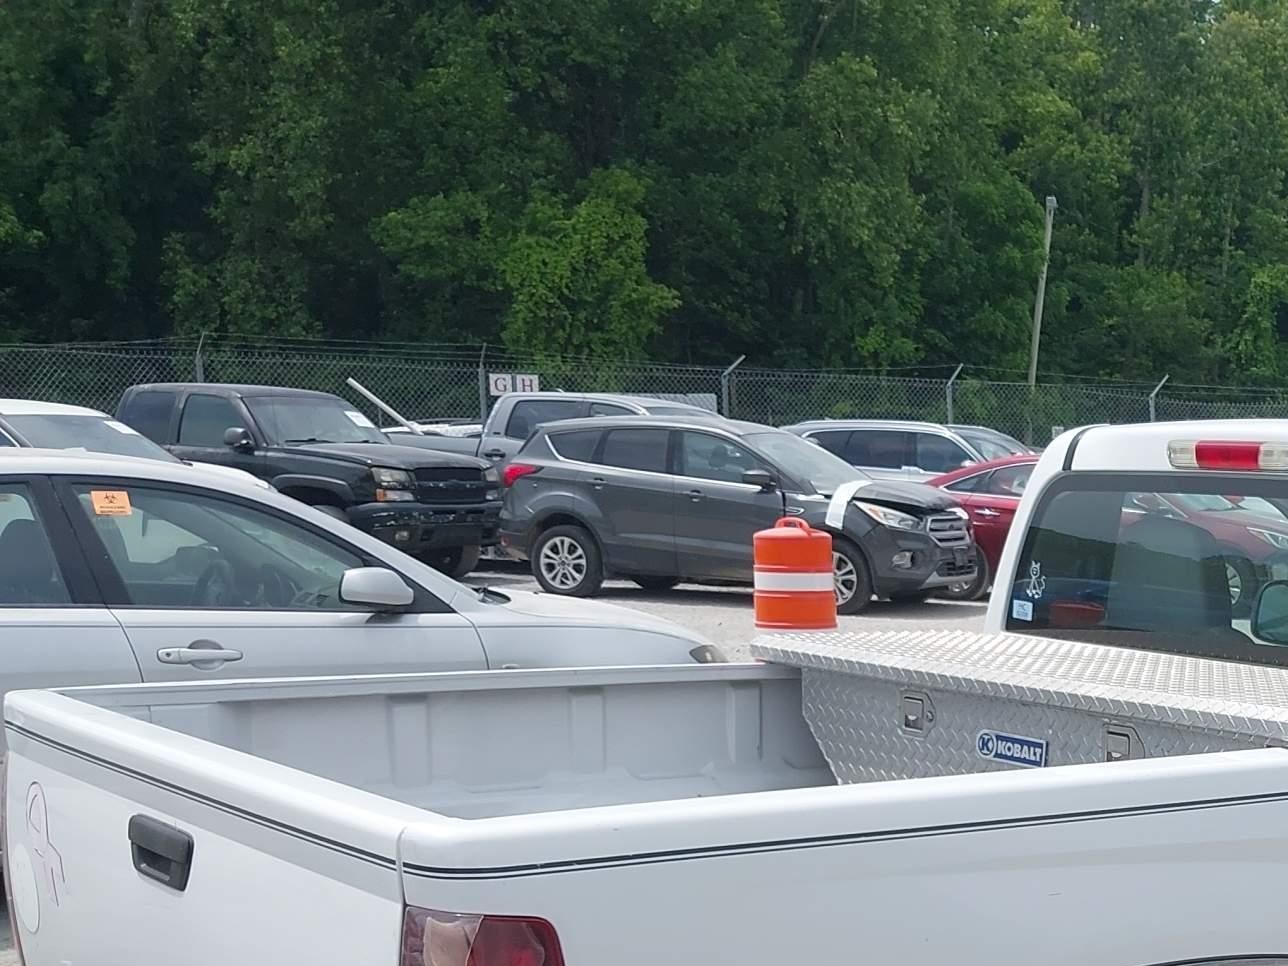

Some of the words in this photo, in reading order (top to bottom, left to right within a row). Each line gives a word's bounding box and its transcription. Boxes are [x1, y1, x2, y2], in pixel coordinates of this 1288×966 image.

[494, 377, 507, 393] G
[521, 377, 533, 393] H
[997, 740, 1042, 762] KOBALT
